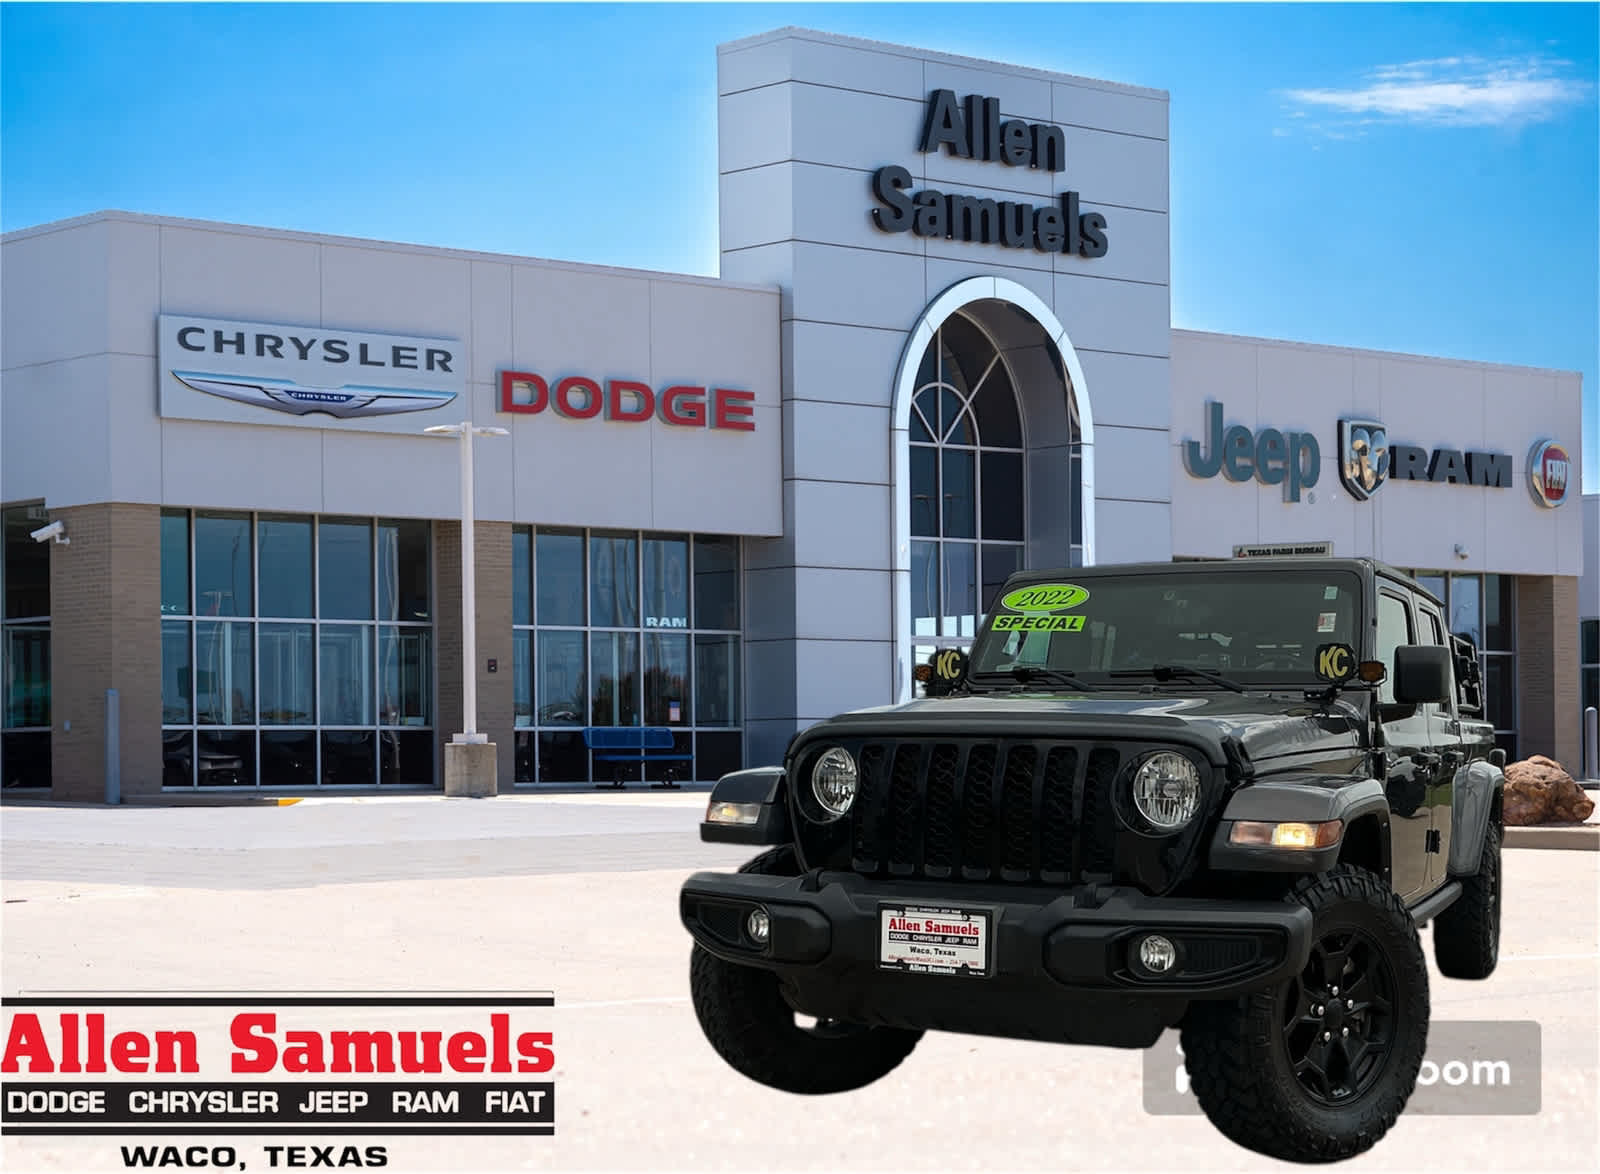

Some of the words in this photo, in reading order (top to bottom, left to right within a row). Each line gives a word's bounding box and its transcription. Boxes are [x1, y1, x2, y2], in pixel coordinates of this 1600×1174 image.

[918, 89, 1065, 172] Allen
[872, 165, 1108, 257] Samuels
[177, 326, 453, 373] CHRYSLER
[291, 392, 346, 401] CHRYSLER
[496, 370, 755, 432] DODGE
[1182, 401, 1321, 503] Jeep
[1389, 445, 1513, 488] RAM
[1248, 548, 1271, 556] TEXAS
[1015, 589, 1076, 607] 2022
[646, 616, 687, 628] RAM
[995, 616, 1079, 630] SPECIAL
[937, 650, 960, 680] KC
[1319, 646, 1349, 679] KC
[888, 917, 921, 932] Allen
[925, 920, 979, 936] Samuels
[912, 934, 943, 943] CHRYSLER
[909, 946, 933, 955] Waco,
[934, 948, 956, 956] Texas
